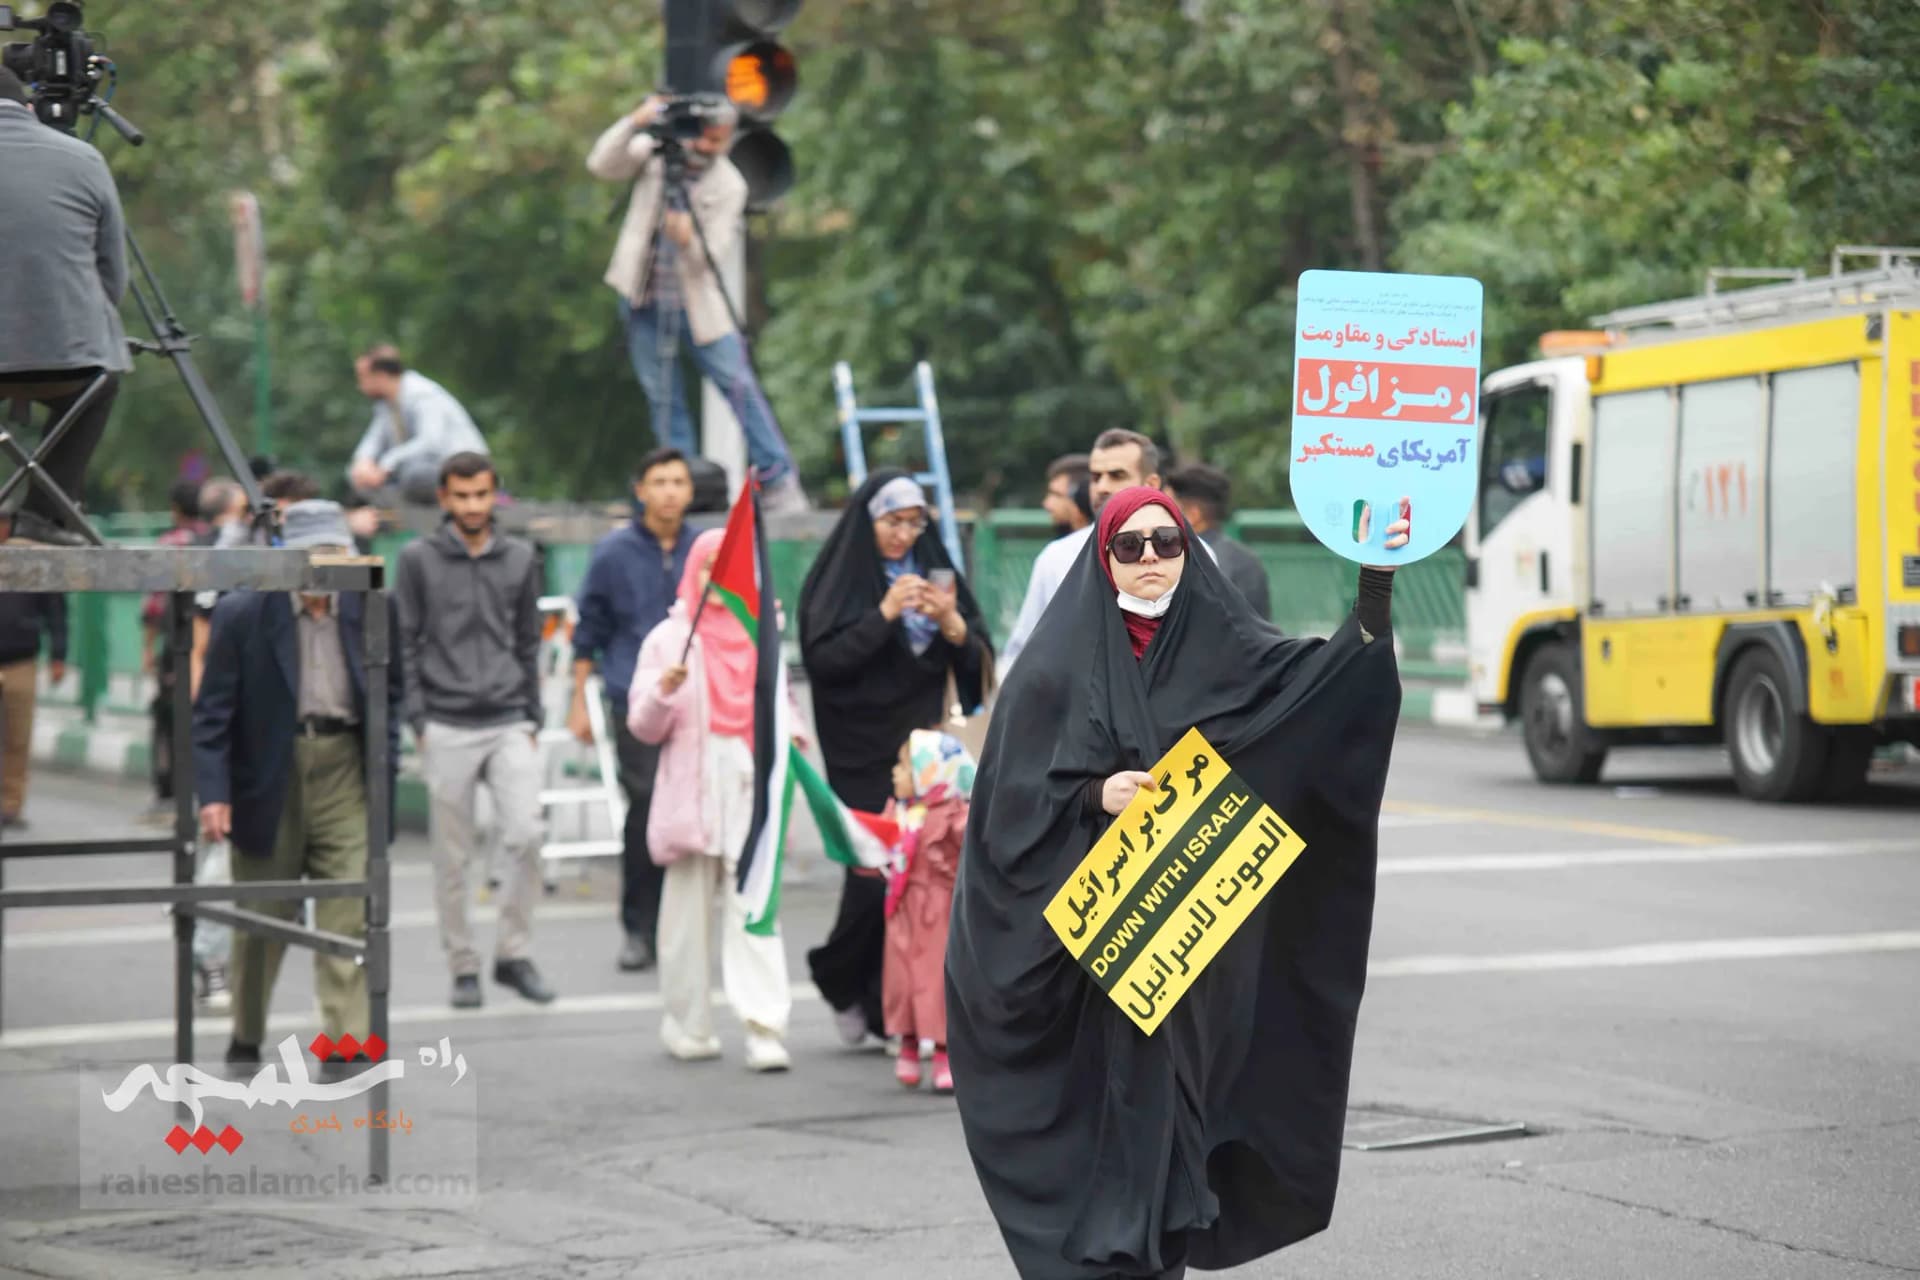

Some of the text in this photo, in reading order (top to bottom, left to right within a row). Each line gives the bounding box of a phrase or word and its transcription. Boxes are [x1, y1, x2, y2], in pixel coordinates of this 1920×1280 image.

[1302, 323, 1475, 354] ایستادگی و مقاومت
[1302, 364, 1472, 421] رمز افول
[1296, 432, 1471, 471] آمریکای مستکبر
[1068, 753, 1210, 940] مرگ بر اسرائیل
[1215, 815, 1288, 907] الموت
[1090, 790, 1250, 979] DOWN WITH ISRAEL
